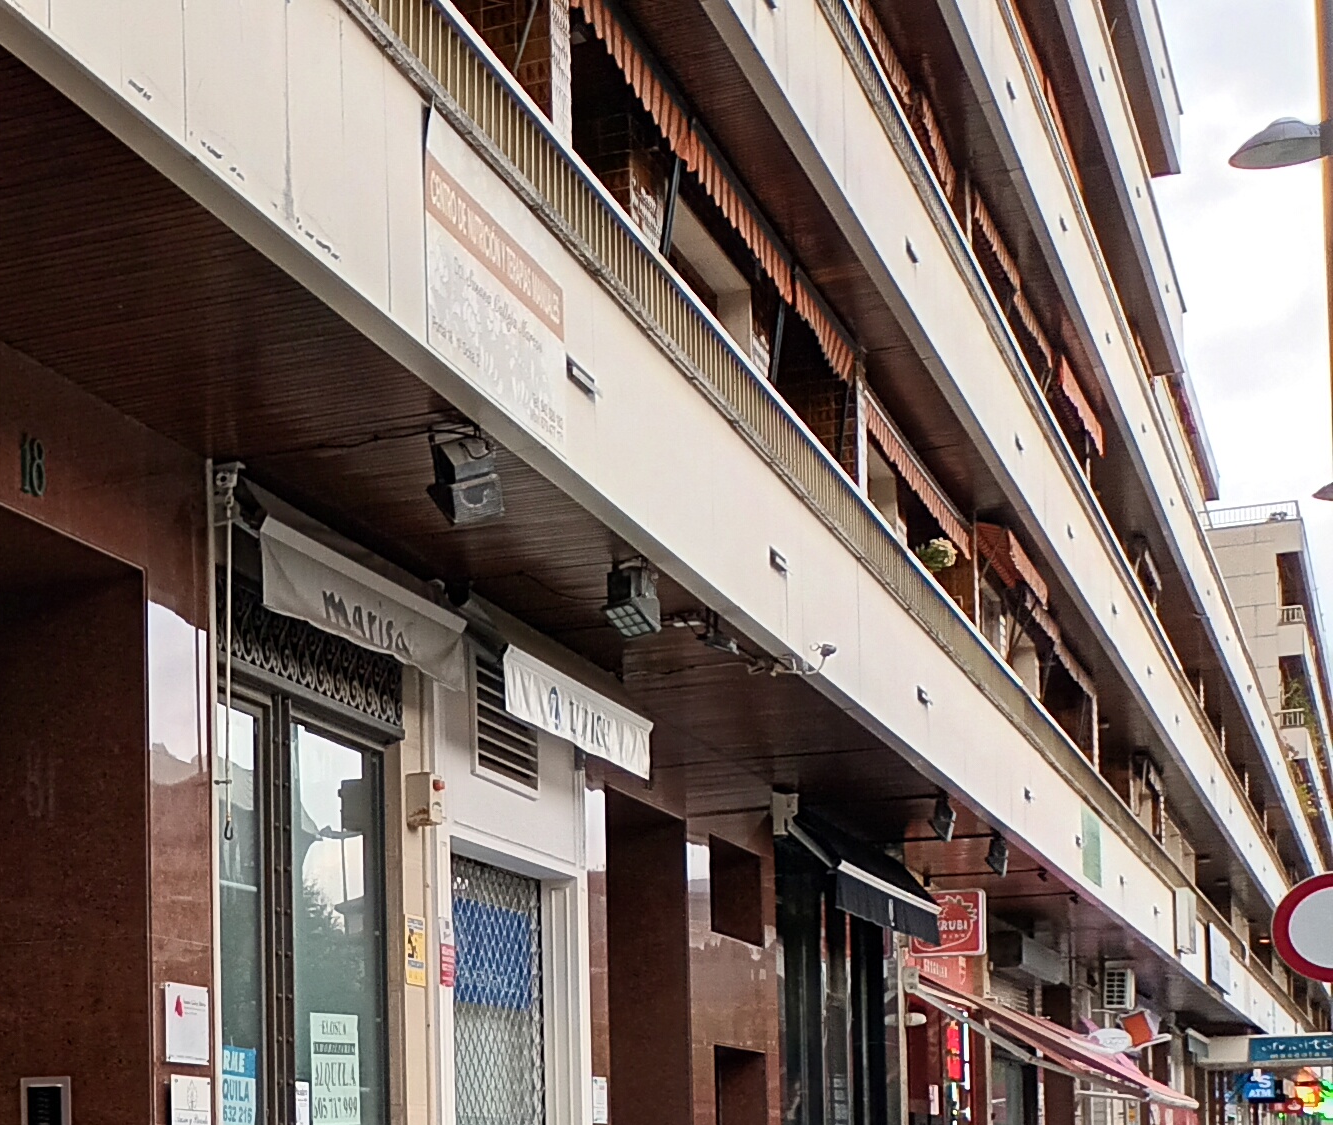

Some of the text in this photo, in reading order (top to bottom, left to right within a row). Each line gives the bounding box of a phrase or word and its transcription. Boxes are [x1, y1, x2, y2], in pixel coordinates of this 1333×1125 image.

[20, 432, 46, 497] 18
[223, 1078, 250, 1103] QUILA
[1248, 1088, 1271, 1097] ATM
